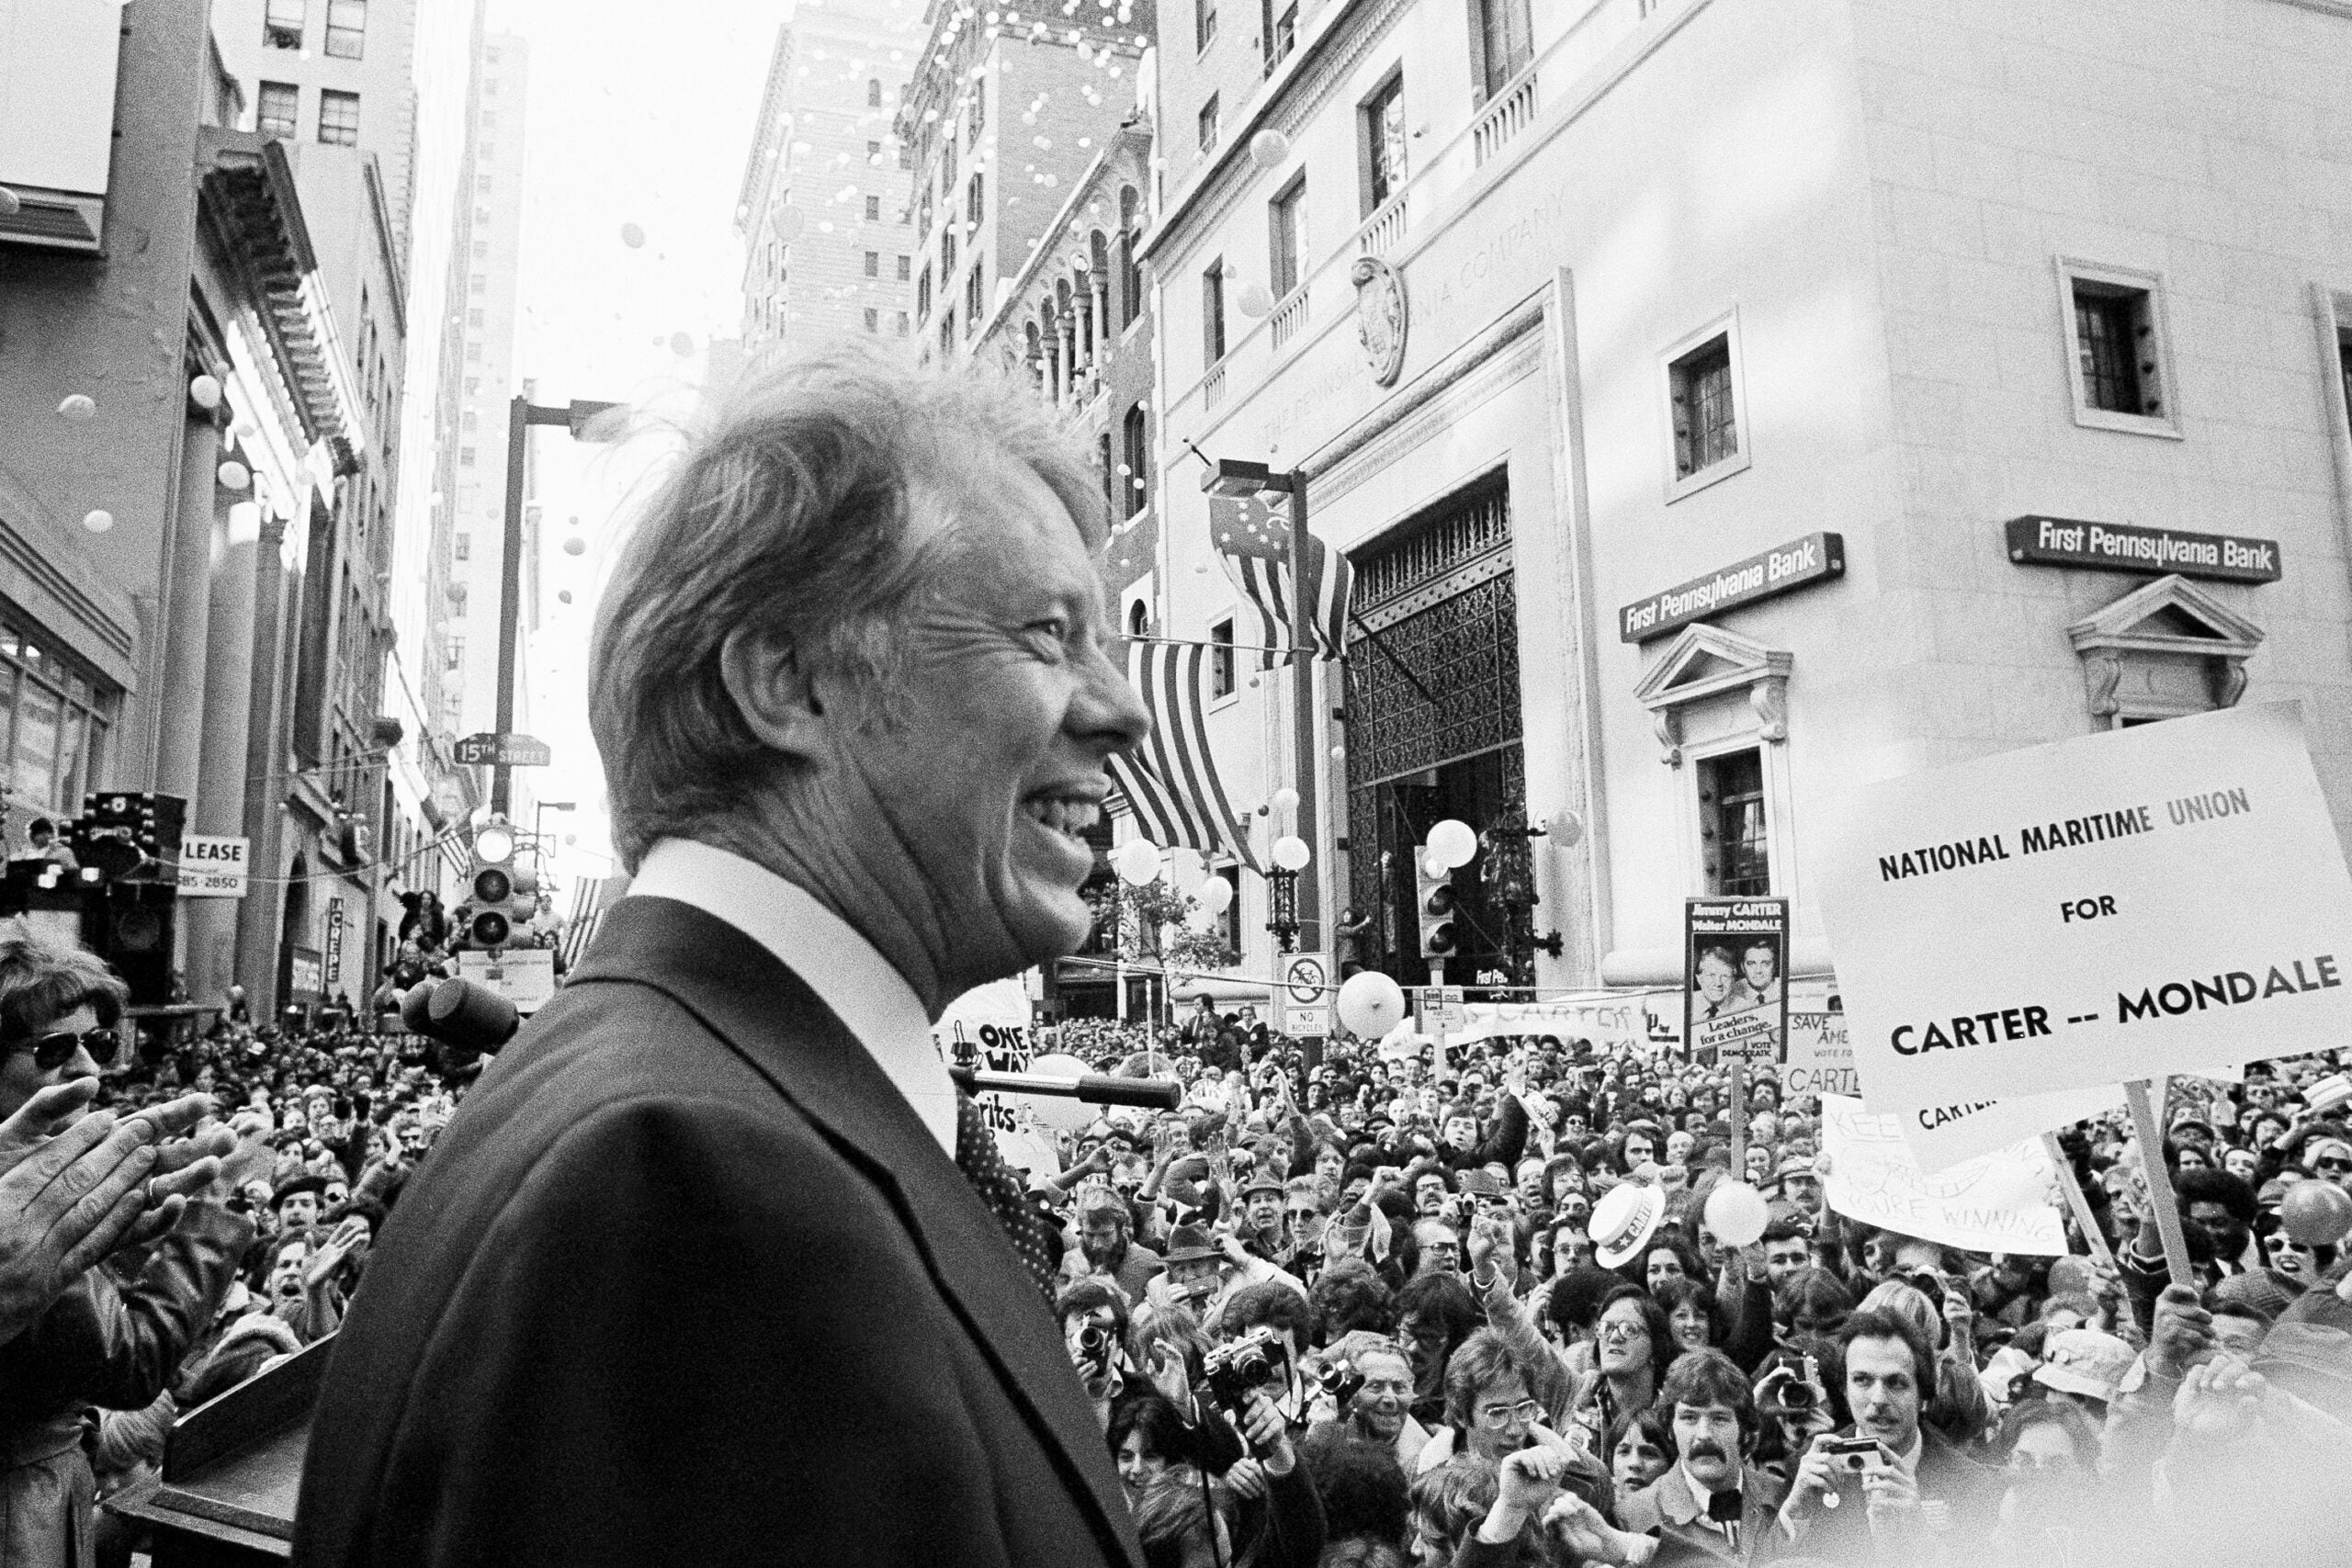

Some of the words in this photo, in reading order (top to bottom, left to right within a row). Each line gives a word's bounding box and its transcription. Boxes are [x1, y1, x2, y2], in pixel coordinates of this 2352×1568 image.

[1459, 185, 1566, 290] COMPANY
[2038, 521, 2085, 552] First
[2089, 525, 2218, 567] Pennsylvania
[2223, 539, 2273, 571] Bank
[1625, 601, 1657, 634] First
[1659, 564, 1764, 622] Pennsylvania
[1768, 541, 1816, 581] Bank
[499, 750, 548, 763] STREET
[1878, 834, 2010, 882] NATIONAL
[2021, 806, 2154, 855] MARITIME
[2166, 787, 2251, 827] UNION
[186, 842, 242, 862] LEASE
[1692, 903, 1731, 919] Jimmy
[1732, 902, 1781, 916] CARTER
[2060, 895, 2118, 923] FOR
[1691, 919, 1725, 931] Walter
[1725, 919, 1782, 931] MONDALE
[1300, 1011, 1314, 1022] NO
[1891, 1005, 2052, 1056] CARTER
[2117, 954, 2343, 1023] MONDALE
[1700, 1034, 1716, 1045] for
[1718, 1032, 1725, 1042] a
[1726, 1021, 1773, 1039] change.
[1709, 1016, 1758, 1032] Leaders,
[1792, 1015, 1830, 1031] SAVE
[978, 1024, 1028, 1052] ONE
[1816, 1029, 1849, 1045] AME
[985, 1050, 1031, 1073] WAY
[1814, 1049, 1839, 1058] VOTE
[1829, 1111, 1901, 1140] KEE
[1940, 1205, 2058, 1243] WINNING
